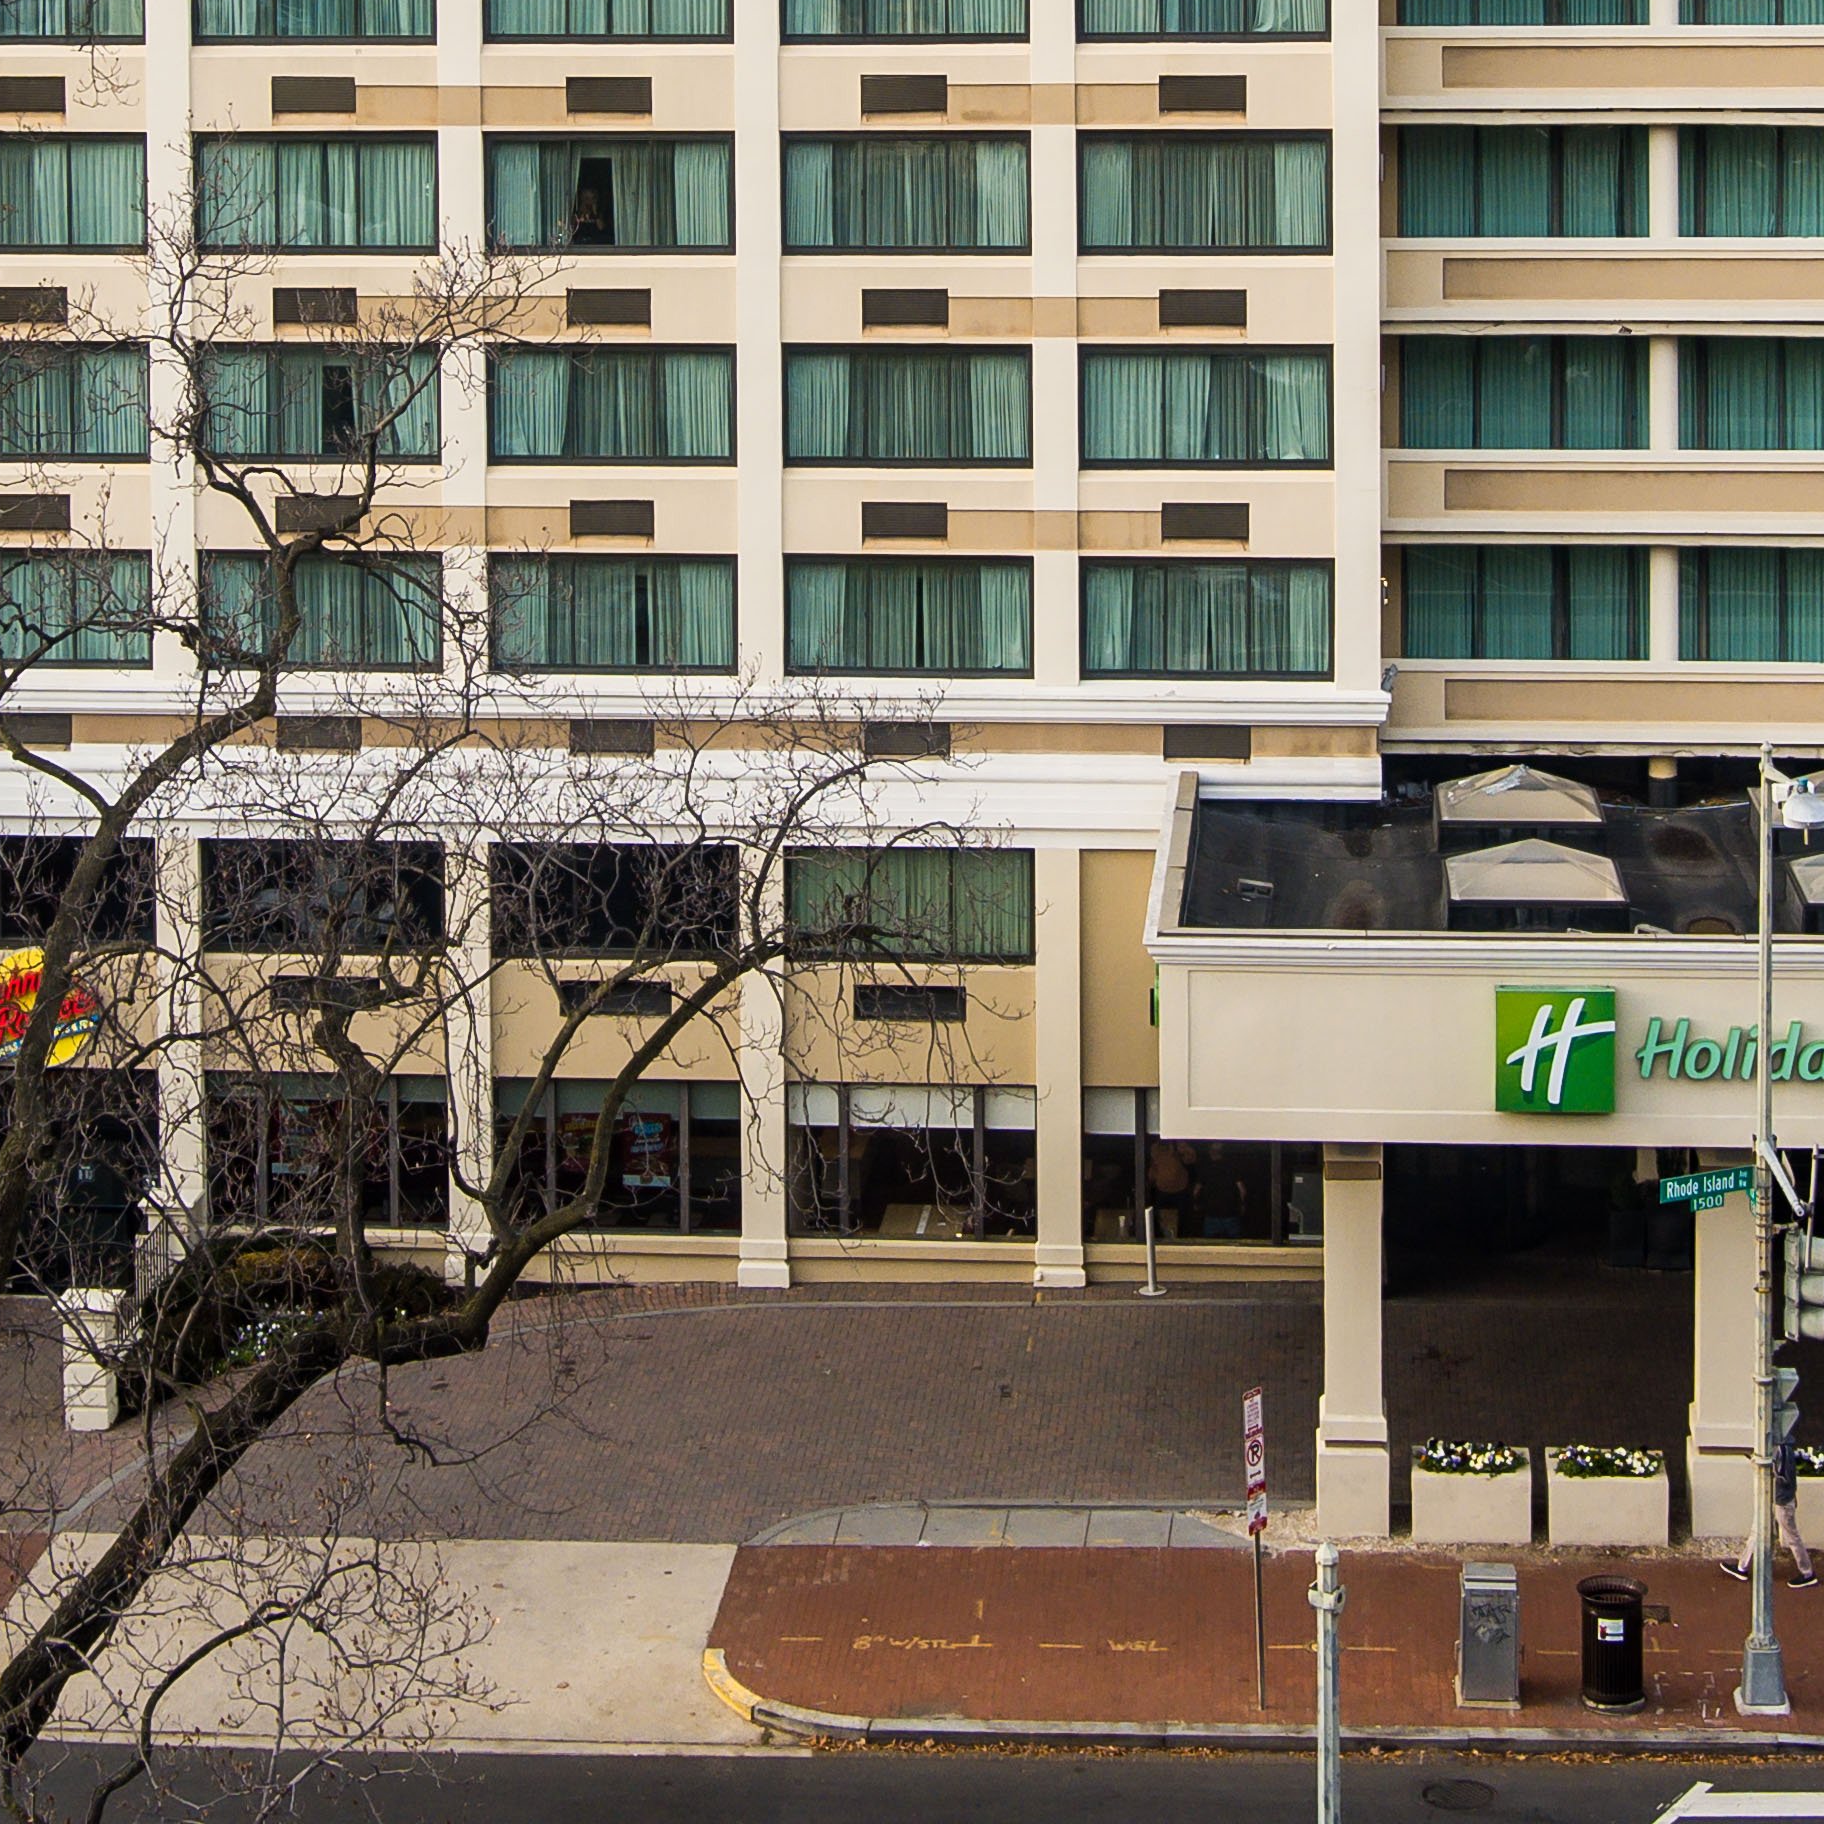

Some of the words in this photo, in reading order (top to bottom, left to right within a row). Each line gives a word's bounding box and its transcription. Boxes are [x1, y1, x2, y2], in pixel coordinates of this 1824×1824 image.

[1666, 1178, 1699, 1200] Rhode
[1703, 1171, 1735, 1193] Island
[1693, 1194, 1723, 1211] 1500
